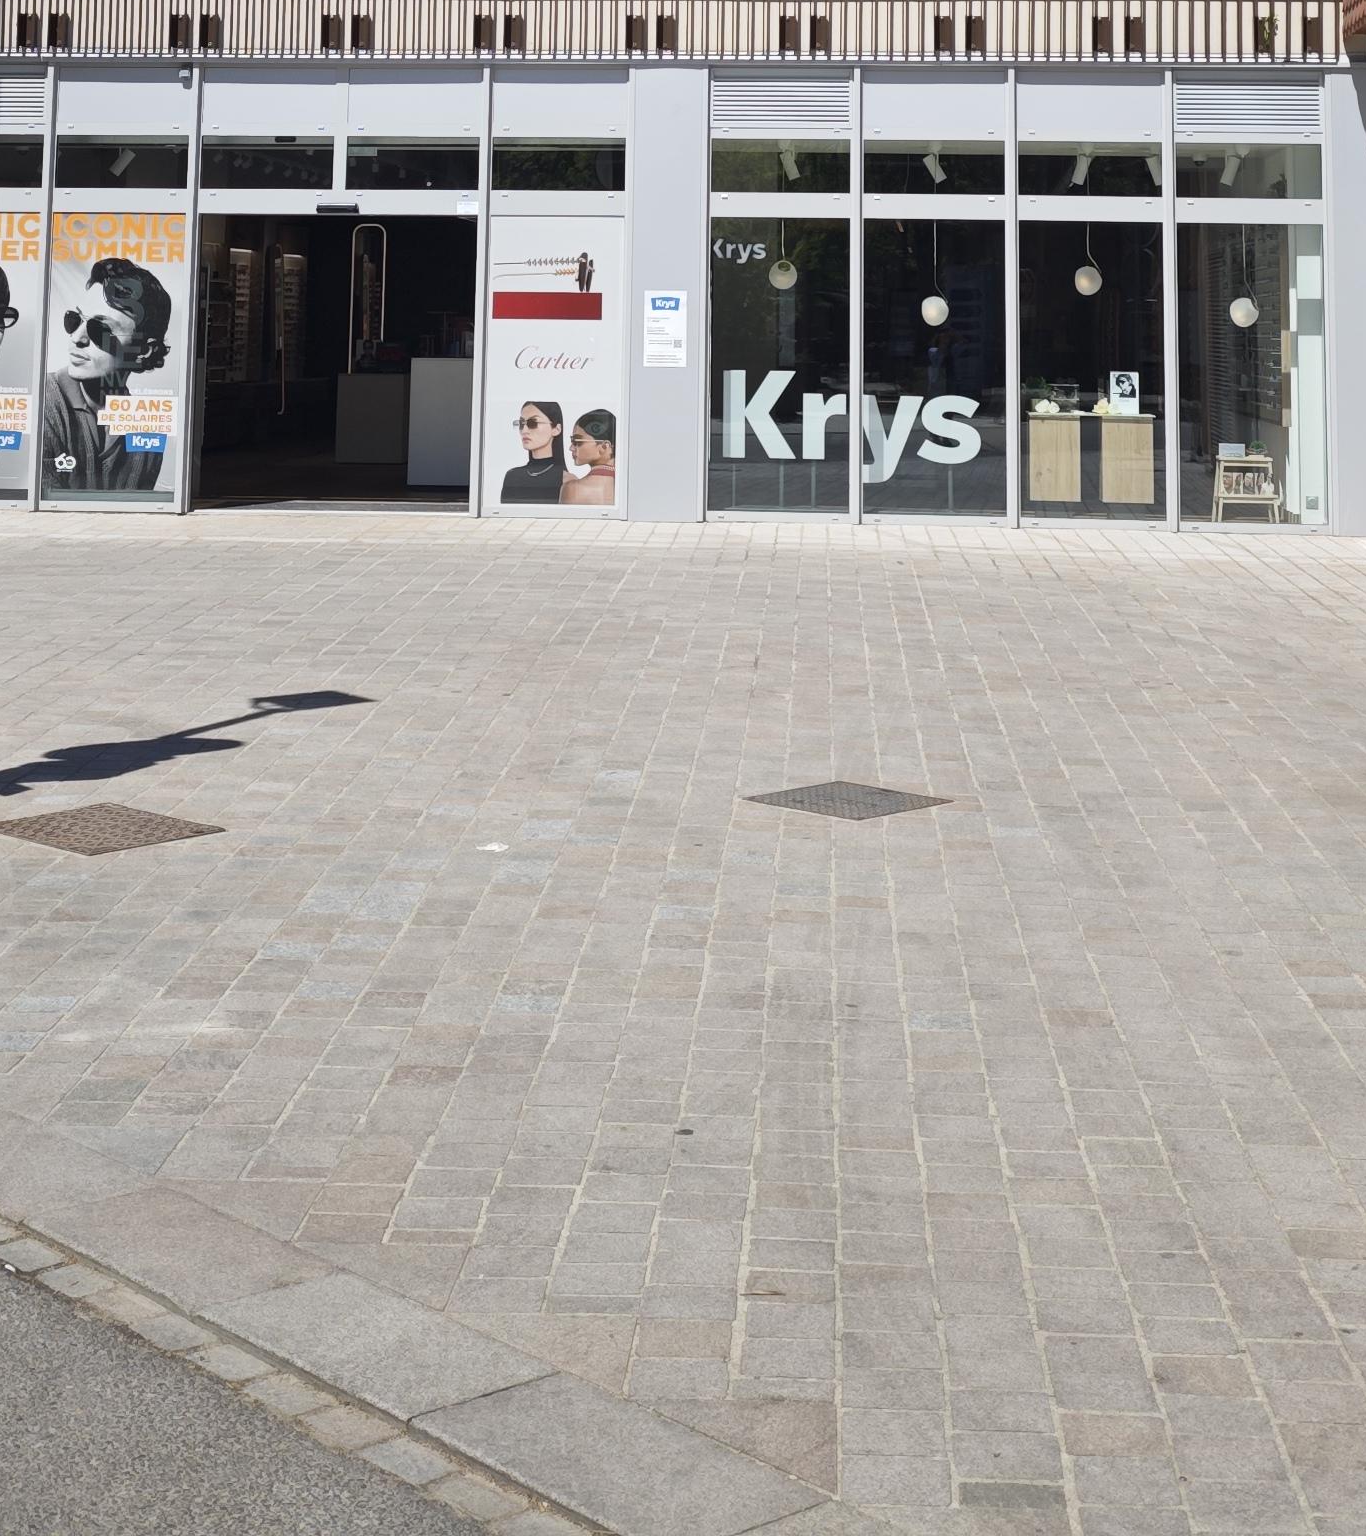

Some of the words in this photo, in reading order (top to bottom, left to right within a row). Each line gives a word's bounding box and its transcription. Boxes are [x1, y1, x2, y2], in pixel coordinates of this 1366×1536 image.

[53, 214, 185, 240] ICONIC
[52, 240, 185, 262] SUMMER
[515, 344, 595, 370] Cartier
[109, 399, 131, 412] 60
[135, 399, 173, 413] ANS
[101, 413, 117, 422] DE
[119, 414, 173, 423] SOLAIRES
[722, 369, 981, 483] Krys
[113, 424, 172, 434] ICONIQUES
[132, 436, 161, 450] Krys
